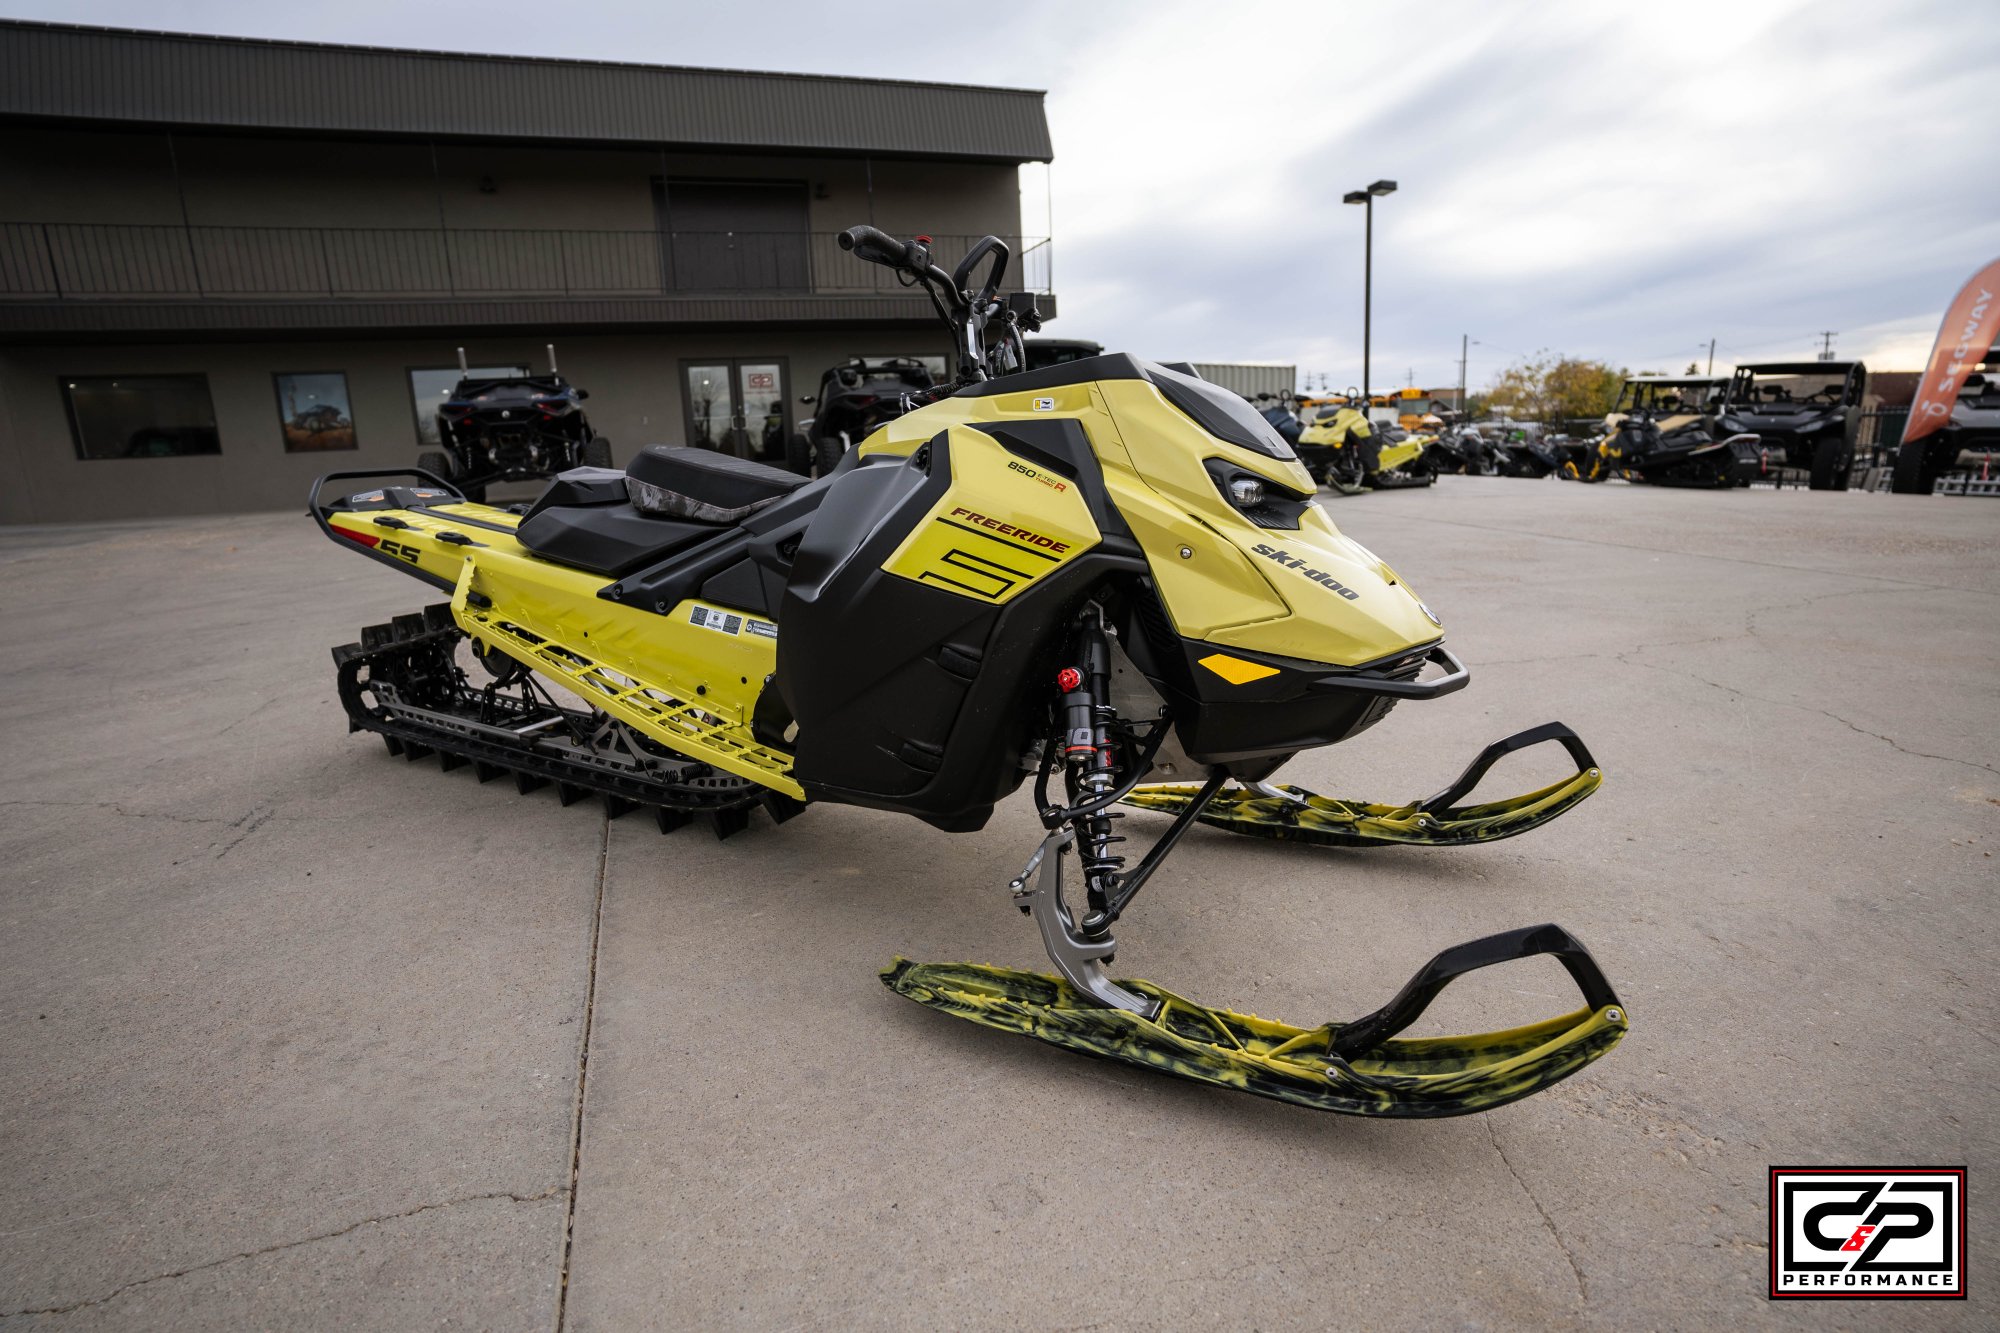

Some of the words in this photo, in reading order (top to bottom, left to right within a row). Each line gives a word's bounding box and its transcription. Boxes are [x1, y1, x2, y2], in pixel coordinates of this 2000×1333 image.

[1938, 288, 1993, 392] SEGWAY
[1008, 462, 1036, 477] 850
[1054, 483, 1066, 492] R
[950, 507, 1071, 554] FREERIDE
